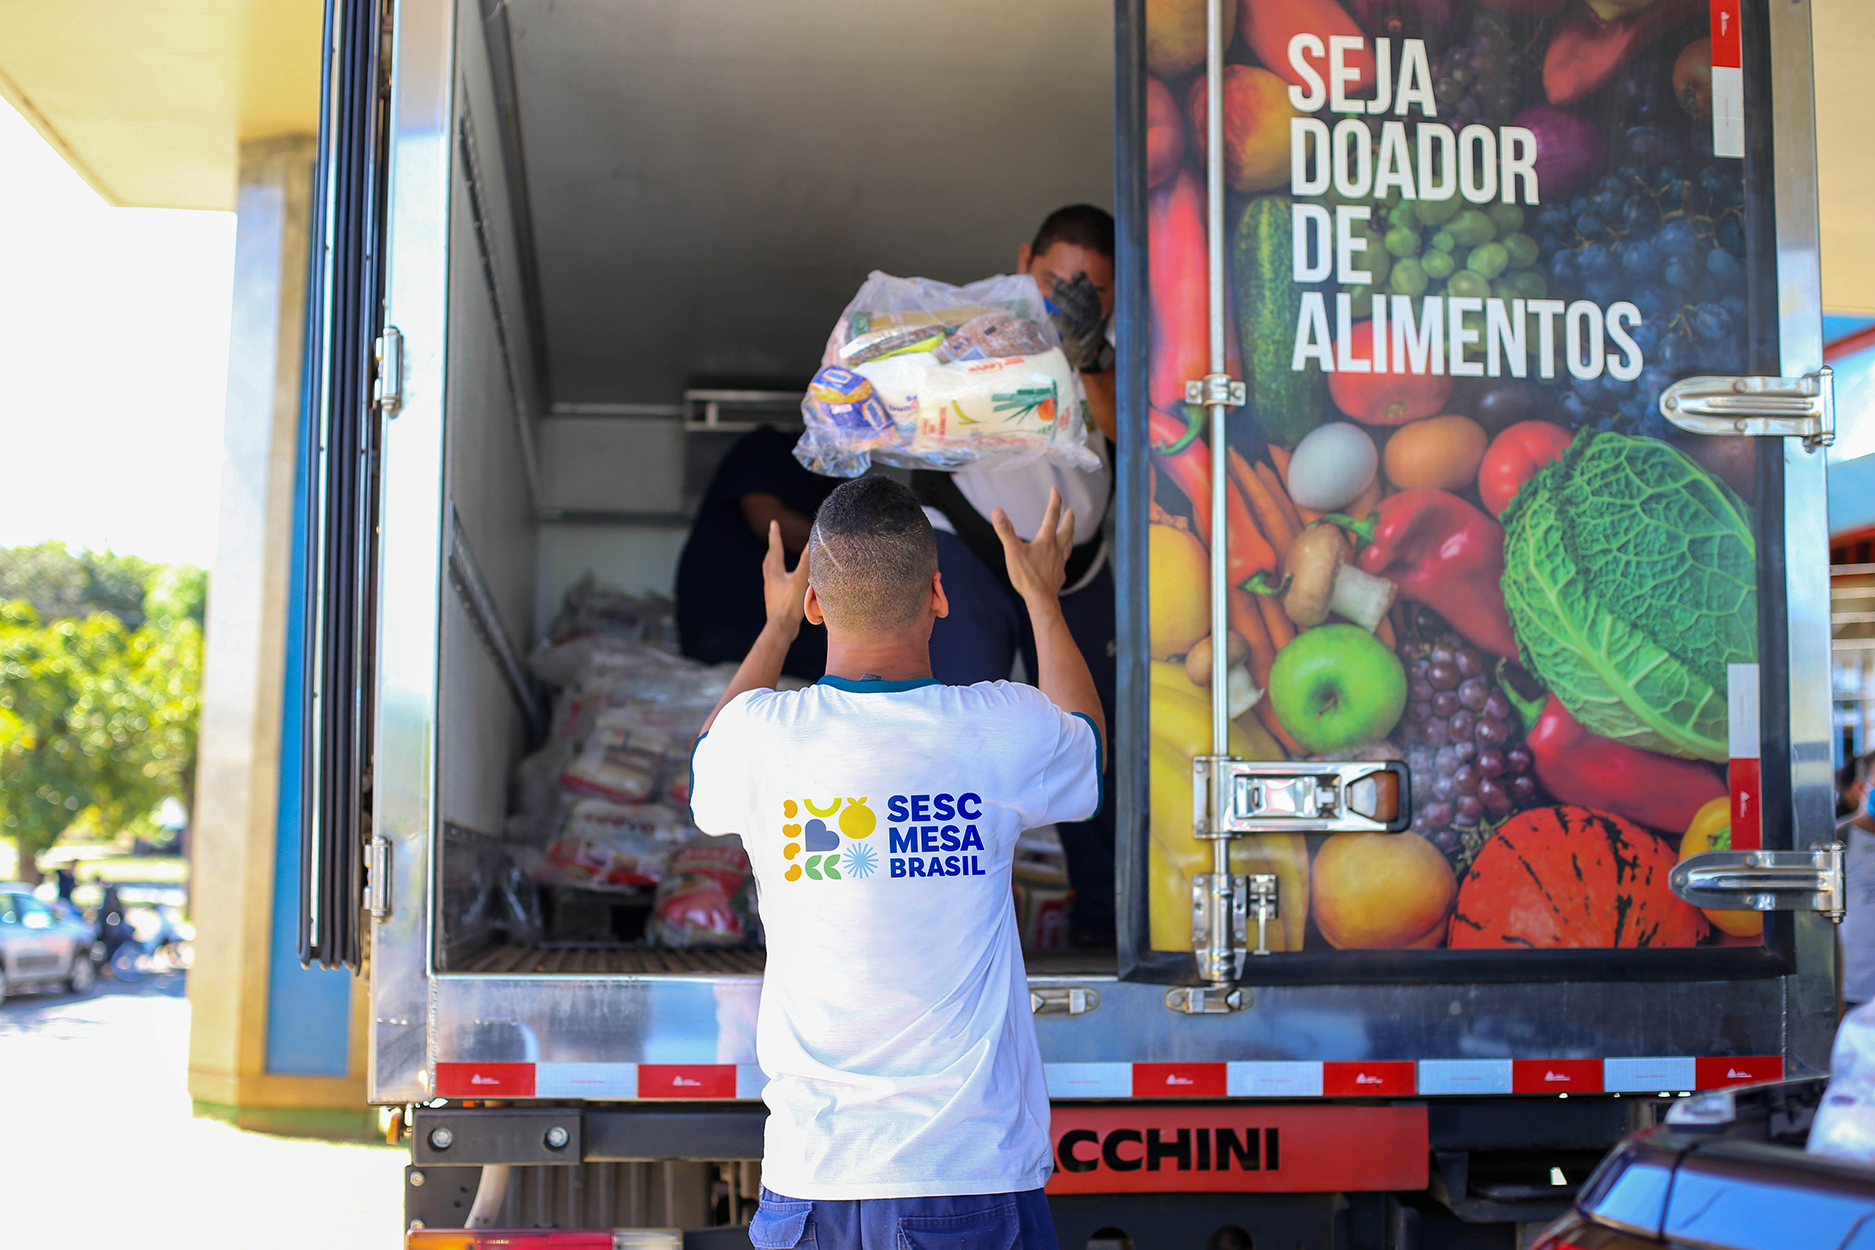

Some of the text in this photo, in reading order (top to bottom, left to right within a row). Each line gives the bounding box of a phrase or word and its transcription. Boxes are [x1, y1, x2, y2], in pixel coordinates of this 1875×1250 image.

[1287, 33, 1437, 117] SEJA
[1290, 117, 1539, 205] DOADOR
[1292, 203, 1372, 285] DE
[1291, 291, 1644, 382] ALIMENTOS
[886, 792, 983, 823] SESC
[888, 824, 985, 854] MESA
[890, 855, 986, 879] BRASIL
[1053, 1127, 1280, 1174] CCHINI
